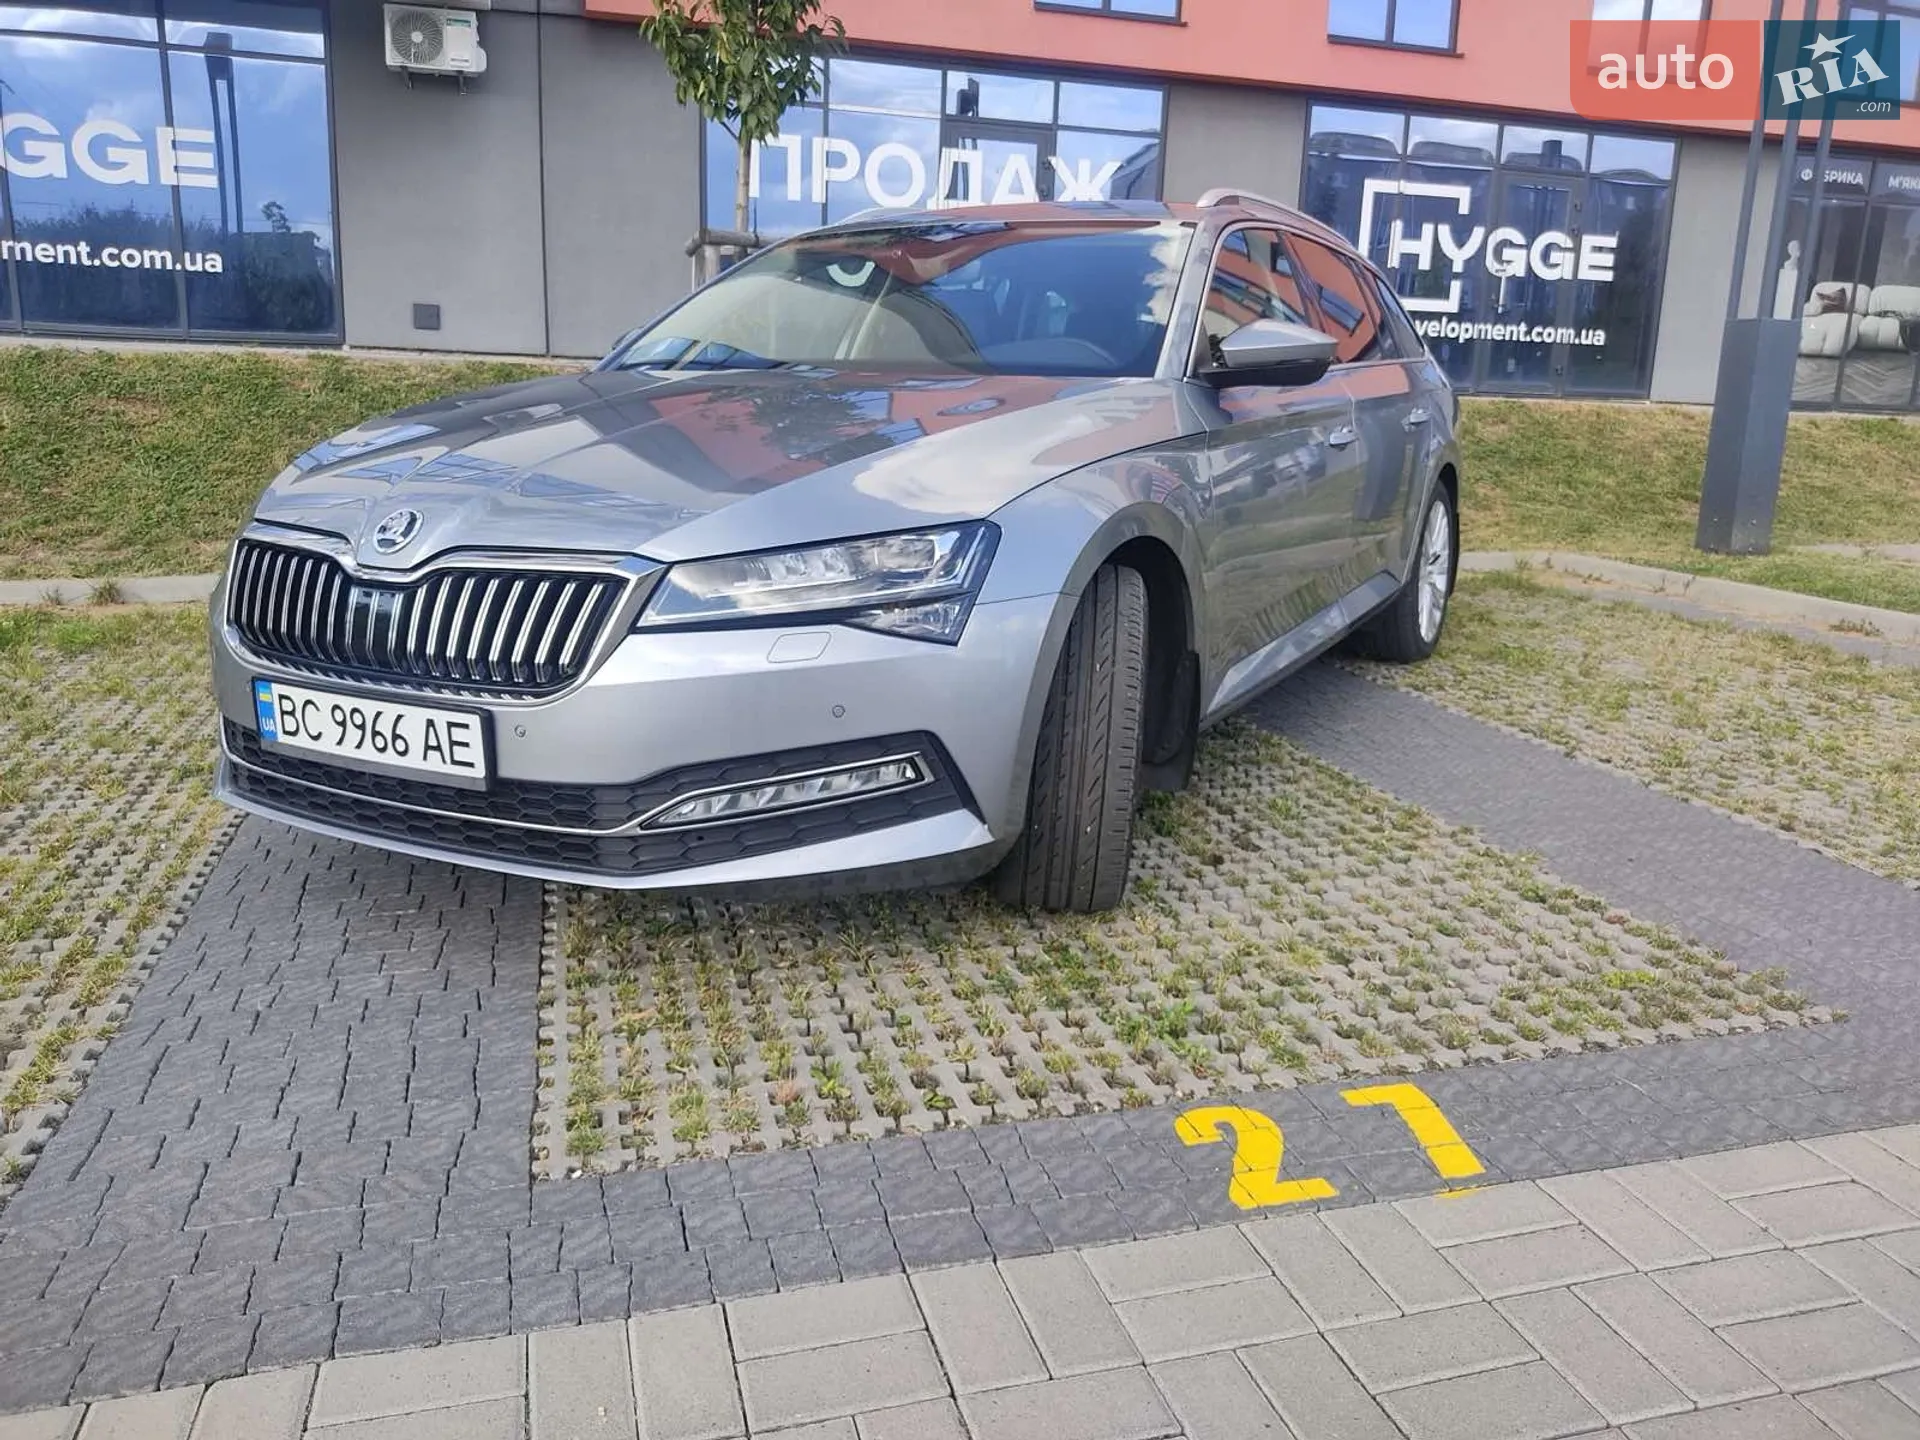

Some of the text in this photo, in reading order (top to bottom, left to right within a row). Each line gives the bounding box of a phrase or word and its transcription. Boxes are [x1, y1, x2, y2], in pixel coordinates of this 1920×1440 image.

[748, 133, 1124, 209] ПРОДАЖ
[1387, 217, 1619, 283] HYGGE
[261, 718, 277, 733] UA
[277, 693, 476, 769] BC 9966 AE
[1172, 1082, 1487, 1210] 27
